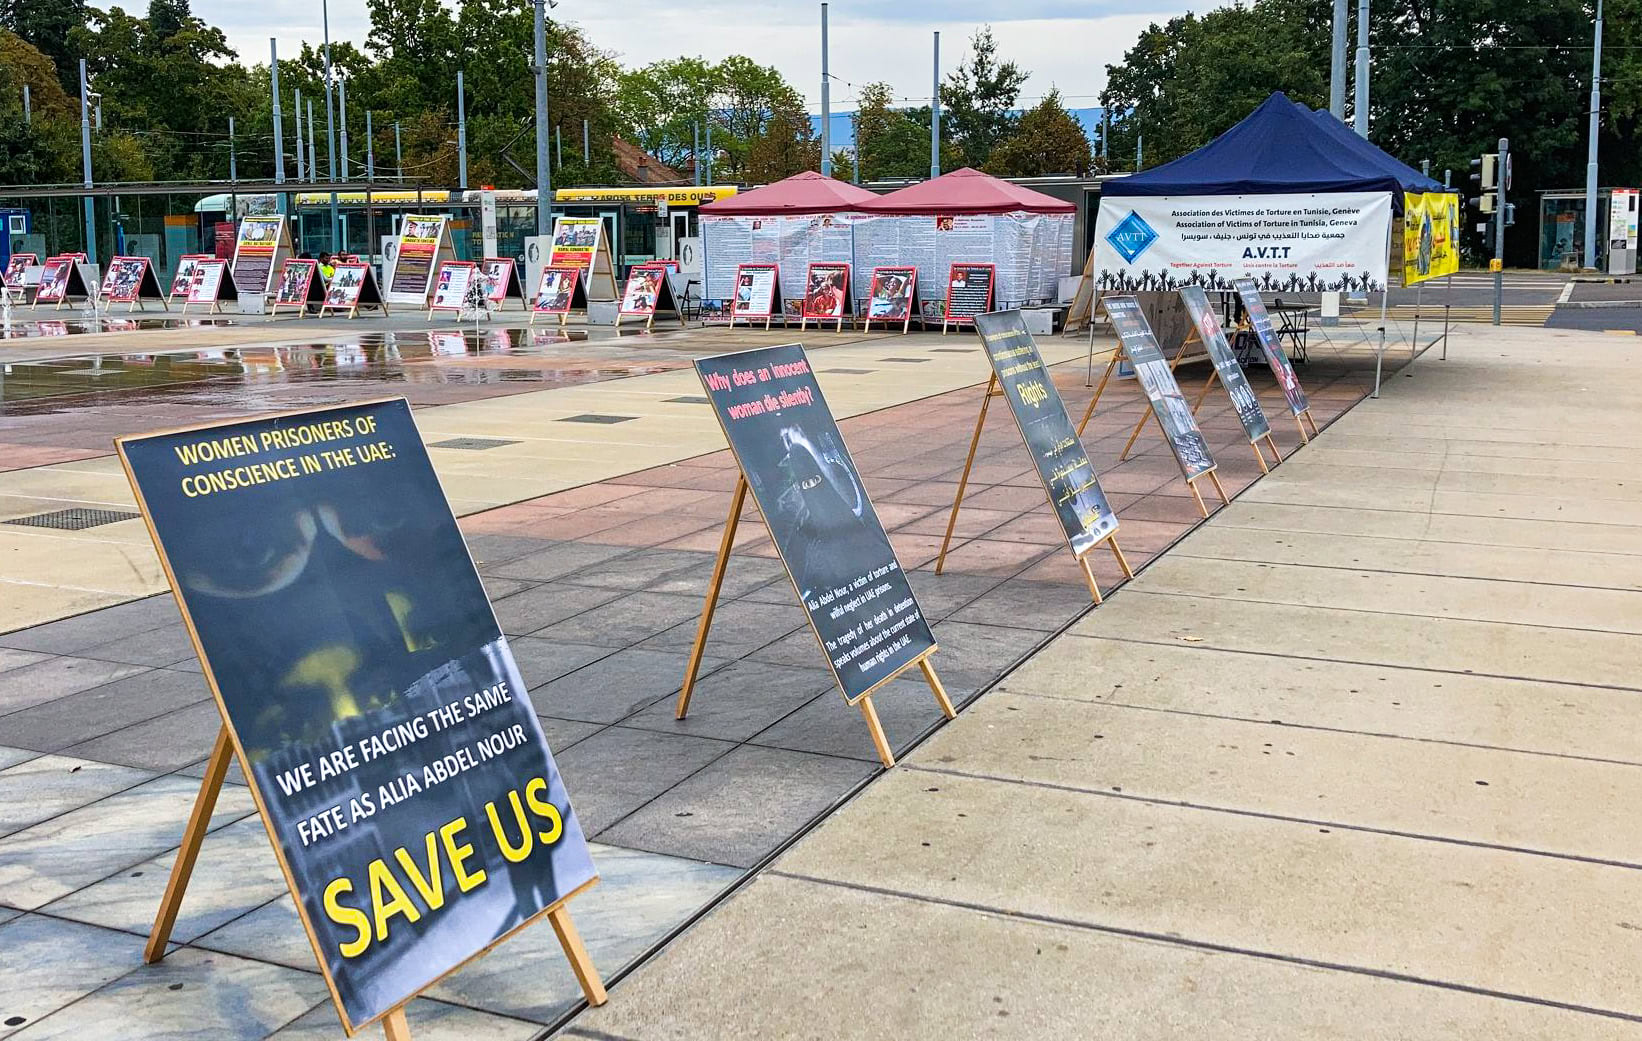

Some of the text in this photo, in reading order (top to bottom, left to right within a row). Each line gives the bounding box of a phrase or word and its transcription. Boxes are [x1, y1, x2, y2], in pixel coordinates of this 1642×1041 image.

[668, 193, 687, 201] DES
[1256, 208, 1264, 216] de
[1266, 208, 1292, 216] Torture
[1304, 208, 1331, 216] Tunisie,
[1332, 206, 1360, 214] Genève
[1117, 232, 1146, 242] AVTT
[1176, 220, 1216, 228] Association
[1217, 220, 1225, 228] of
[1226, 220, 1252, 228] Victims
[1300, 220, 1328, 228] Tunisia,
[1242, 246, 1291, 259] A.V.T.T
[704, 371, 732, 392] Why
[732, 368, 757, 386] does
[758, 367, 772, 382] an
[1016, 380, 1048, 408] Rights
[727, 386, 814, 420] woman die silently?
[174, 416, 376, 466] WOMEN PRISONERS OF
[181, 442, 397, 498] CONSCIENCE IN THE UAE:
[808, 599, 820, 612] Alia
[818, 590, 835, 607] Abdel
[849, 584, 854, 592] a
[853, 576, 868, 589] victim
[868, 570, 873, 582] of
[872, 566, 890, 579] torture
[888, 559, 898, 572] and
[844, 594, 862, 612] neglect
[860, 595, 866, 604] in
[864, 588, 876, 601] UAE
[826, 597, 914, 652] The tragedy of her death in detention
[834, 609, 921, 670] speaks volumes about the current state of
[858, 656, 877, 673] human
[876, 648, 890, 663] rights
[888, 646, 895, 655] in
[892, 640, 901, 650] the
[276, 681, 512, 797] WE ARE FACING THE SAME
[296, 724, 528, 847] FATE AS ALIA ABDEL NOUR
[322, 777, 564, 959] SAVE US
